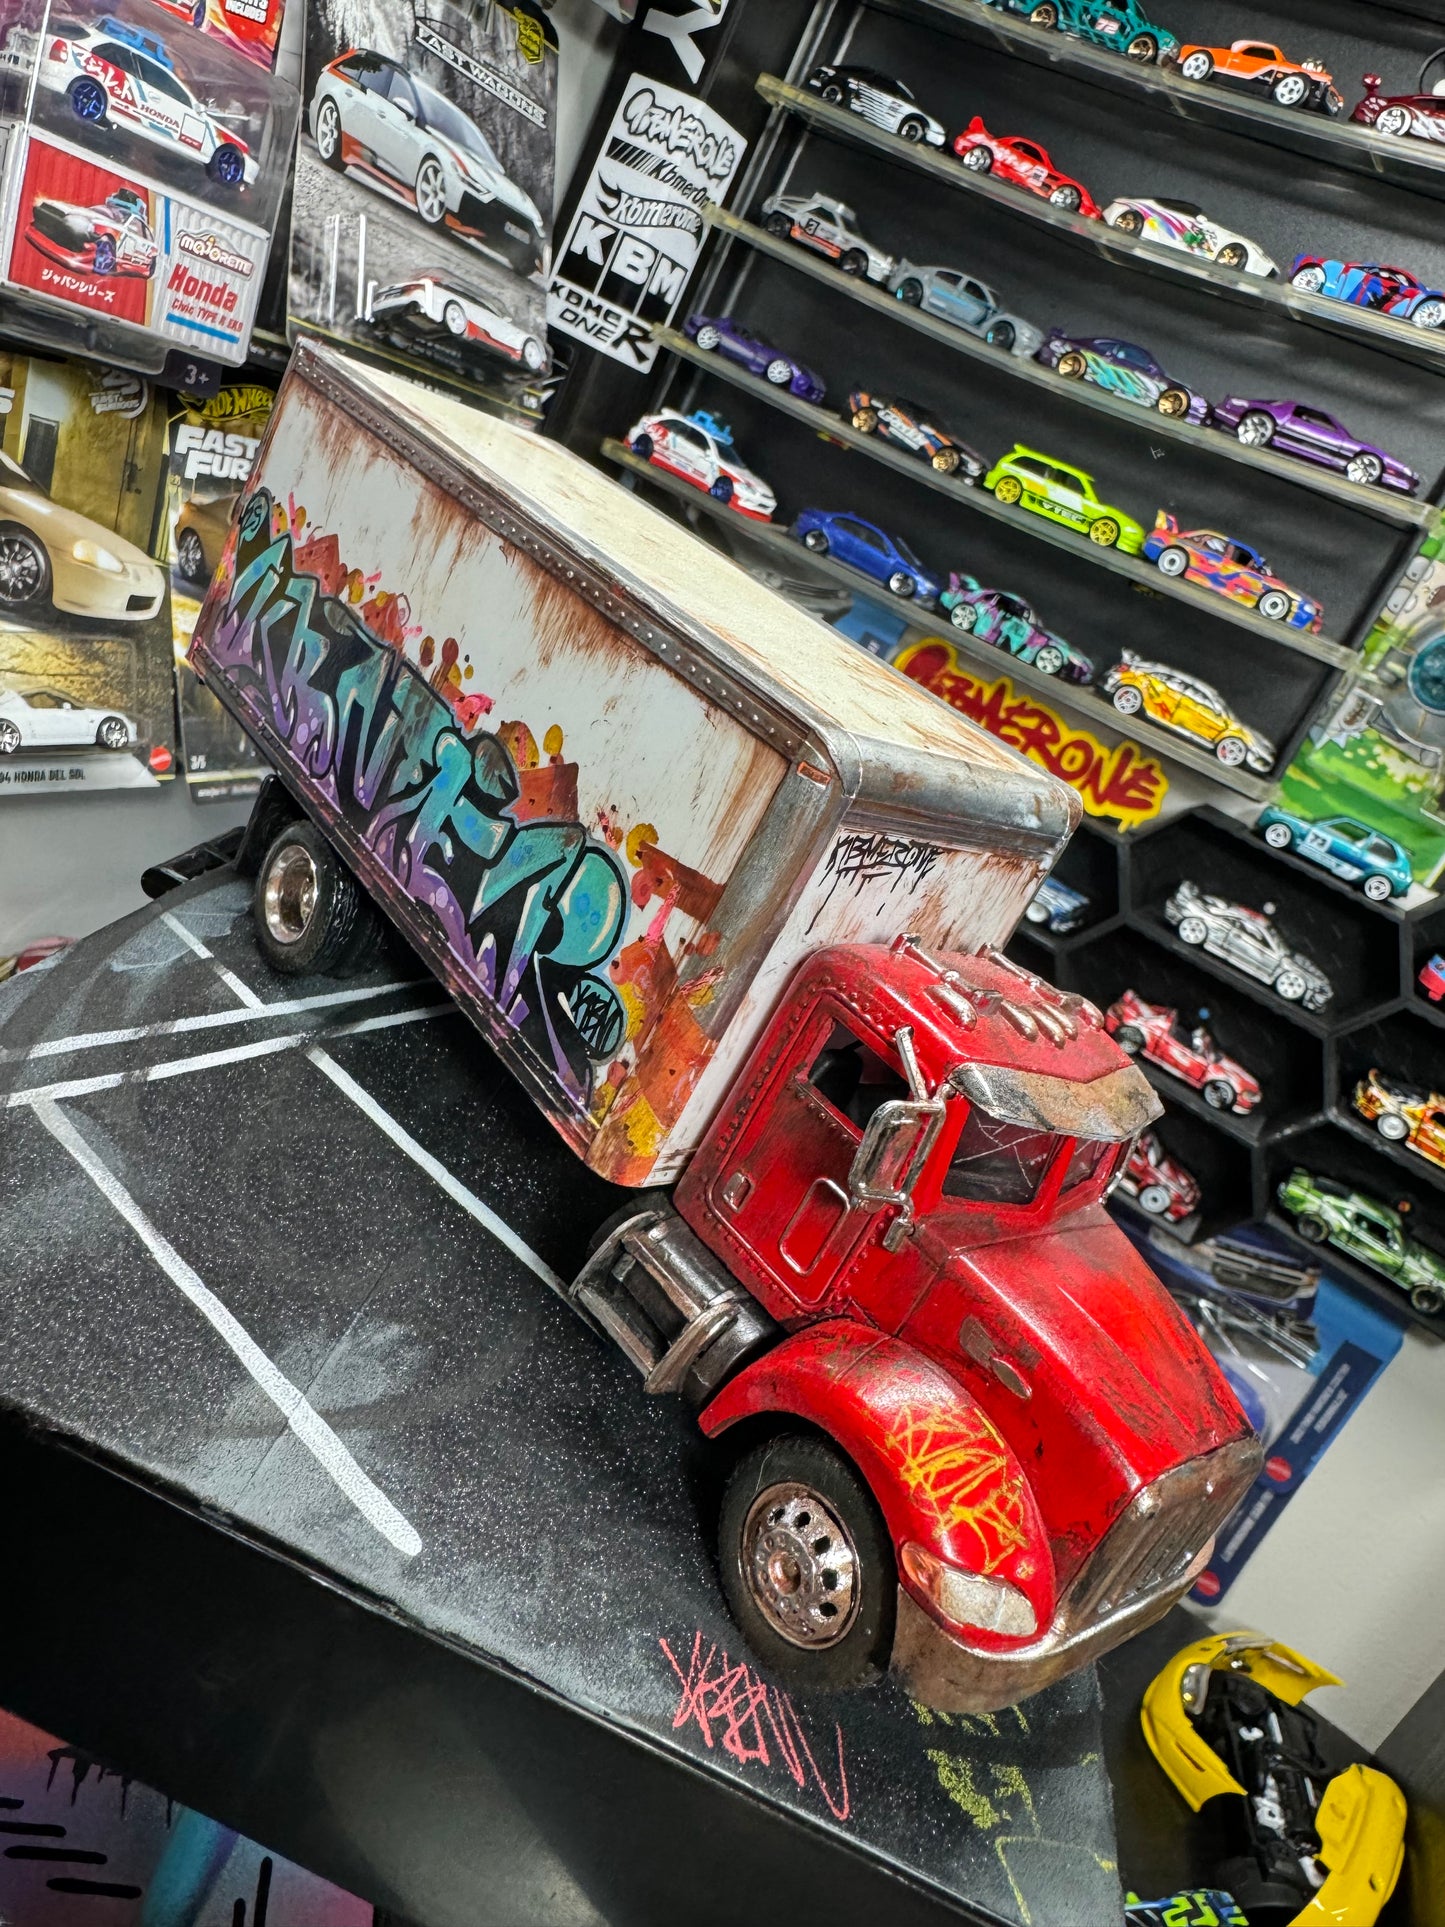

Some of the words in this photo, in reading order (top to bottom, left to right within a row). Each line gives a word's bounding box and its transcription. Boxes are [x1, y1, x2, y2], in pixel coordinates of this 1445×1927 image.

[140, 103, 180, 129] HONDA
[650, 158, 717, 208] KbmerOn
[569, 215, 689, 305] KBM
[41, 268, 117, 304] ジャパンシリーズ
[167, 263, 239, 313] Honda
[185, 364, 210, 385] 3+
[175, 423, 261, 460] FAST
[15, 769, 46, 784] HONDA
